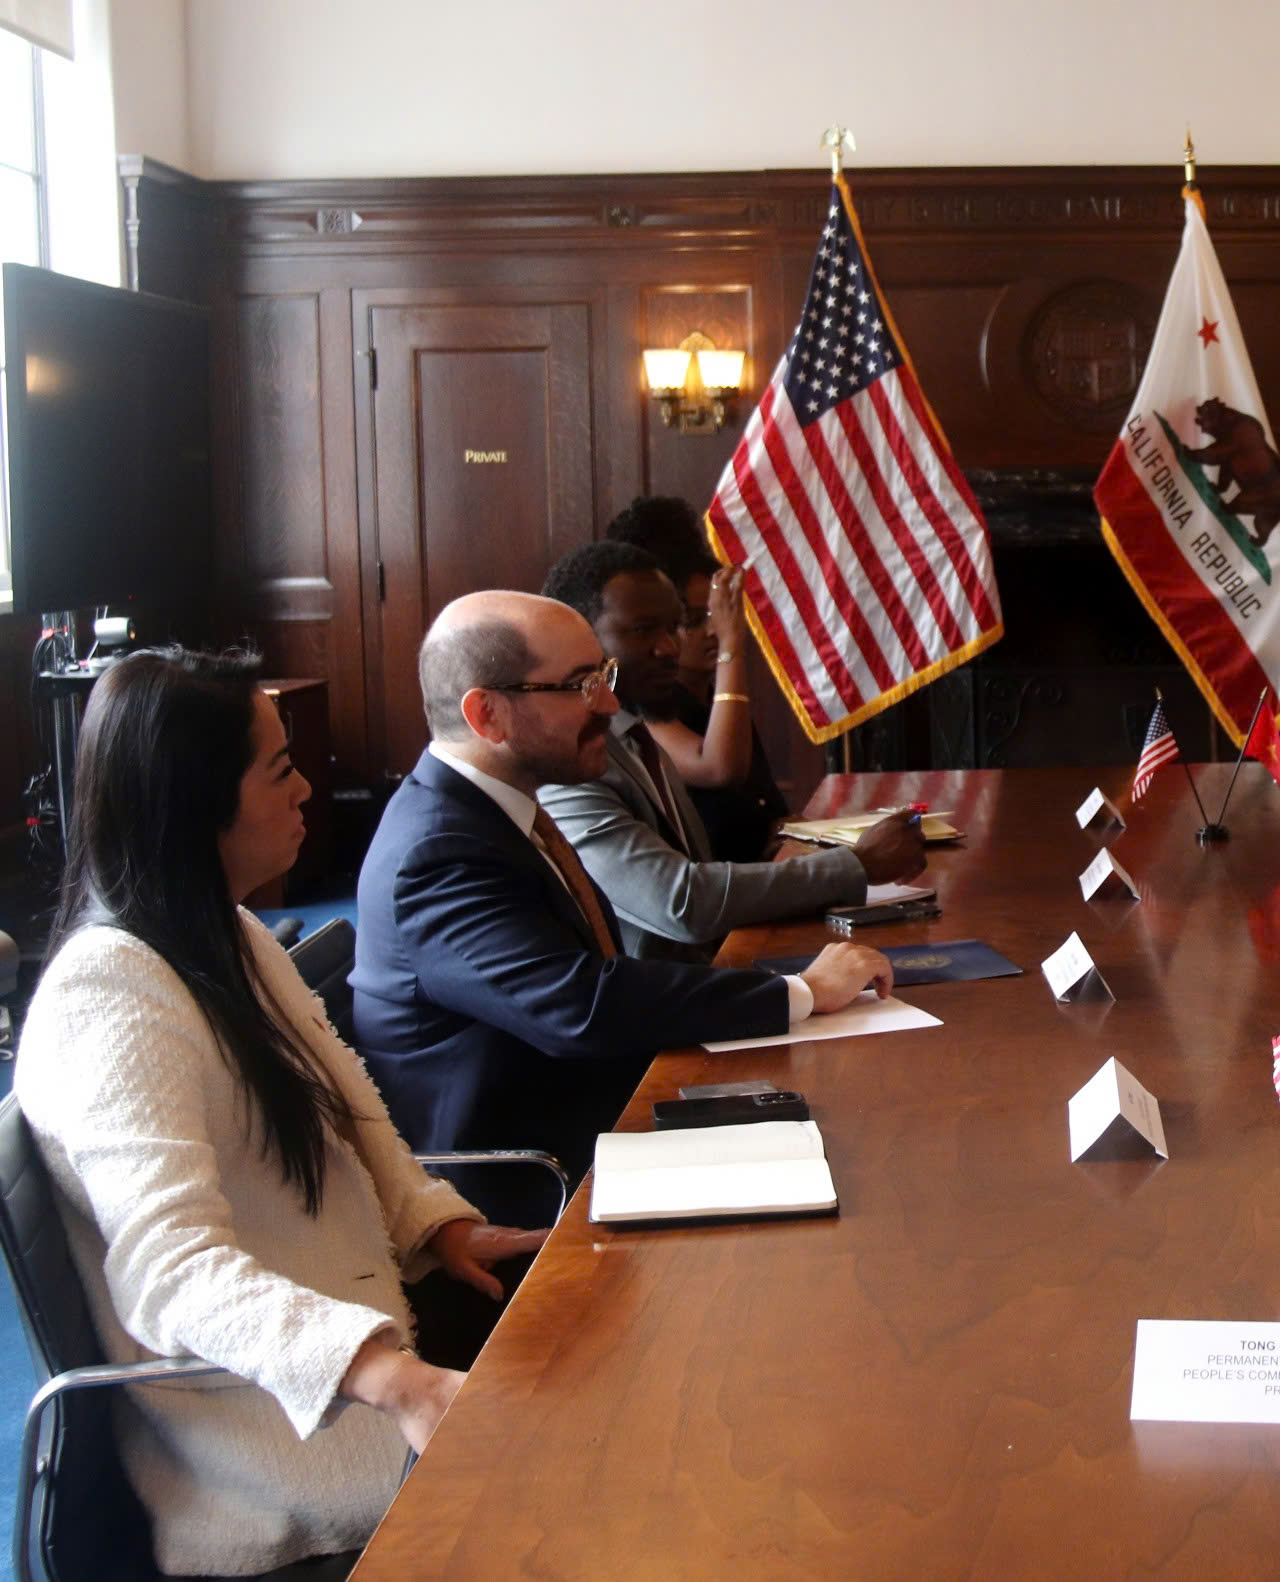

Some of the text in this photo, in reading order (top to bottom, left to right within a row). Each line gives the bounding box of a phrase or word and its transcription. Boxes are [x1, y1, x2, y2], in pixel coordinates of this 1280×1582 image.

[465, 449, 507, 463] PRIVATE
[1127, 413, 1261, 620] CALIFORNIA REPUBLIC
[1240, 1340, 1275, 1351] TONG
[1183, 1369, 1245, 1381] PEOPLE'S
